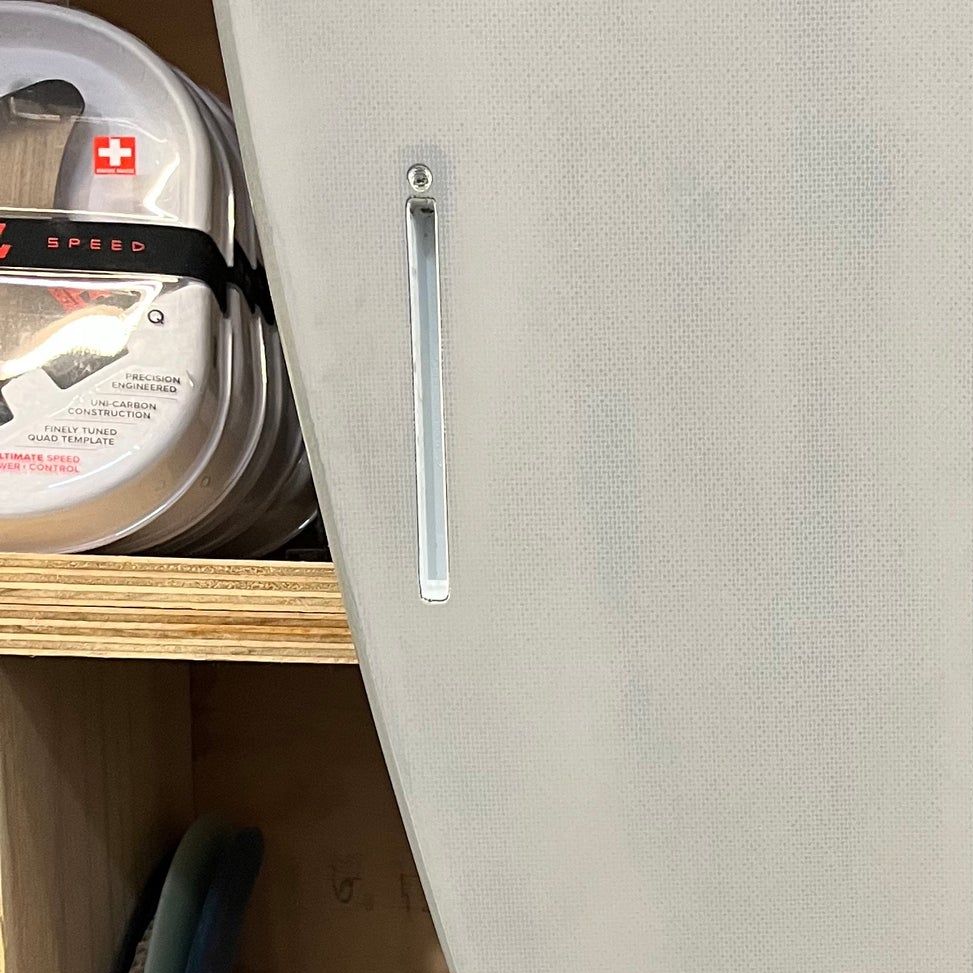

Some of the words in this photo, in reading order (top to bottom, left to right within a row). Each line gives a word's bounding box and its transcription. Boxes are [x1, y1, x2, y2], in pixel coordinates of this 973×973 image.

[47, 236, 146, 252] SPEED
[147, 309, 165, 325] Q
[125, 372, 181, 385] PRECISION
[111, 381, 178, 393] ENGINEERED
[91, 399, 157, 411] UNI-CARBON
[67, 407, 152, 420] CONSTRUCTION
[44, 424, 79, 434] FINELY
[82, 427, 118, 436] TUNED
[27, 433, 59, 442] QUAD
[62, 435, 115, 446] TEMPLATE
[46, 454, 81, 464] SPEED
[29, 463, 81, 473] CONTROL
